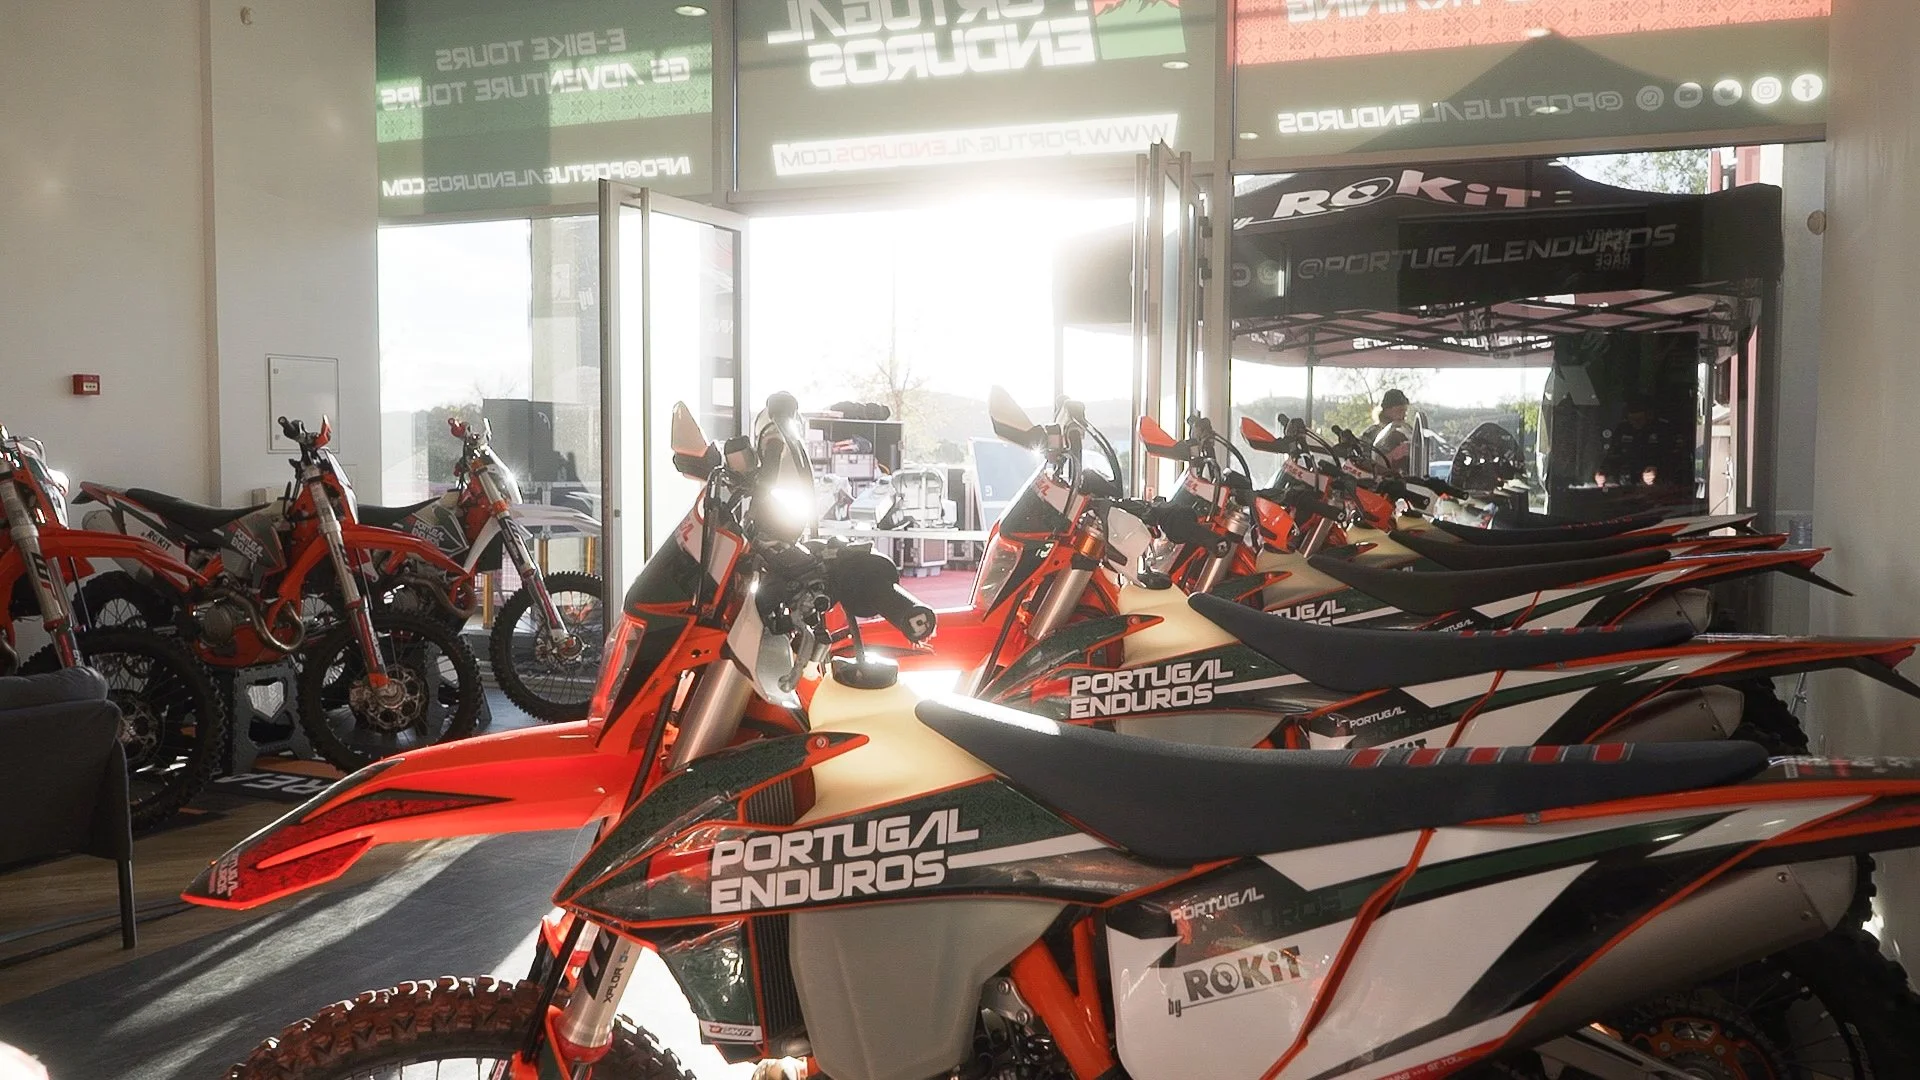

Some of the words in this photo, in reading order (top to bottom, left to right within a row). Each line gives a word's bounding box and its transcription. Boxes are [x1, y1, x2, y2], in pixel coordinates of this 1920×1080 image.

[1071, 659, 1234, 697] PORTUGAL
[1071, 683, 1214, 719] ENDUROS
[1349, 706, 1406, 729] PORTUGAL
[711, 808, 979, 876] PORTUGAL
[711, 850, 945, 914] ENDUROS
[1171, 887, 1264, 924] PORTUGAL
